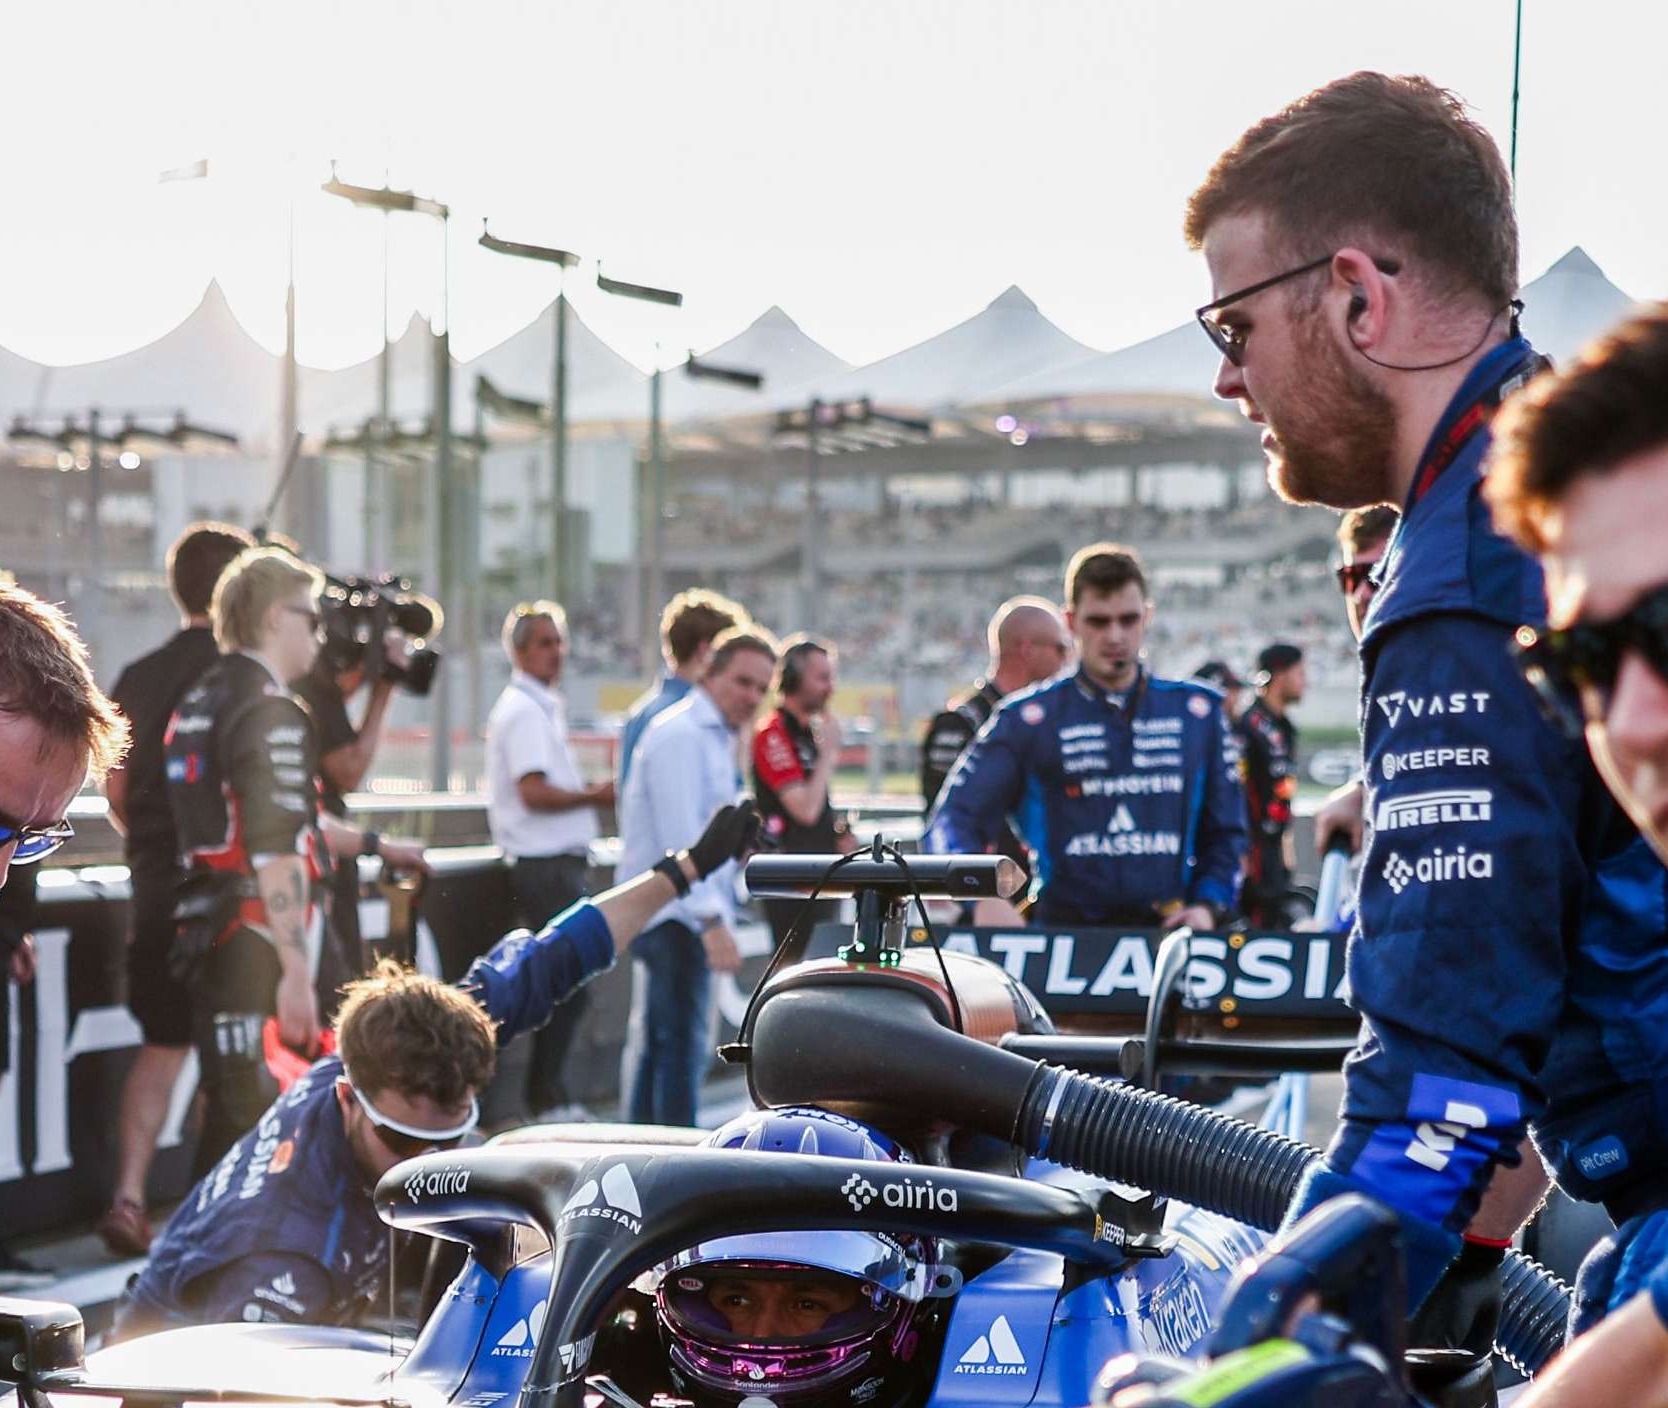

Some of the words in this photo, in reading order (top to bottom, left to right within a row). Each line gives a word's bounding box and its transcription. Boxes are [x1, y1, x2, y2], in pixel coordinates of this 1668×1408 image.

[1408, 693, 1490, 717] VAST
[1395, 748, 1491, 772] KEEPER
[1375, 790, 1493, 831] PIRELLI
[1416, 847, 1493, 882] airia
[940, 933, 1354, 1000] TLASSI
[426, 1165, 471, 1197] airia
[883, 1178, 959, 1213] airia
[556, 1207, 643, 1235] ATLASSIAN
[1102, 1222, 1126, 1247] KEEPER
[492, 1346, 536, 1358] ATLASS
[954, 1364, 1028, 1377] ATLASSIAN
[734, 1379, 781, 1390] Santander
